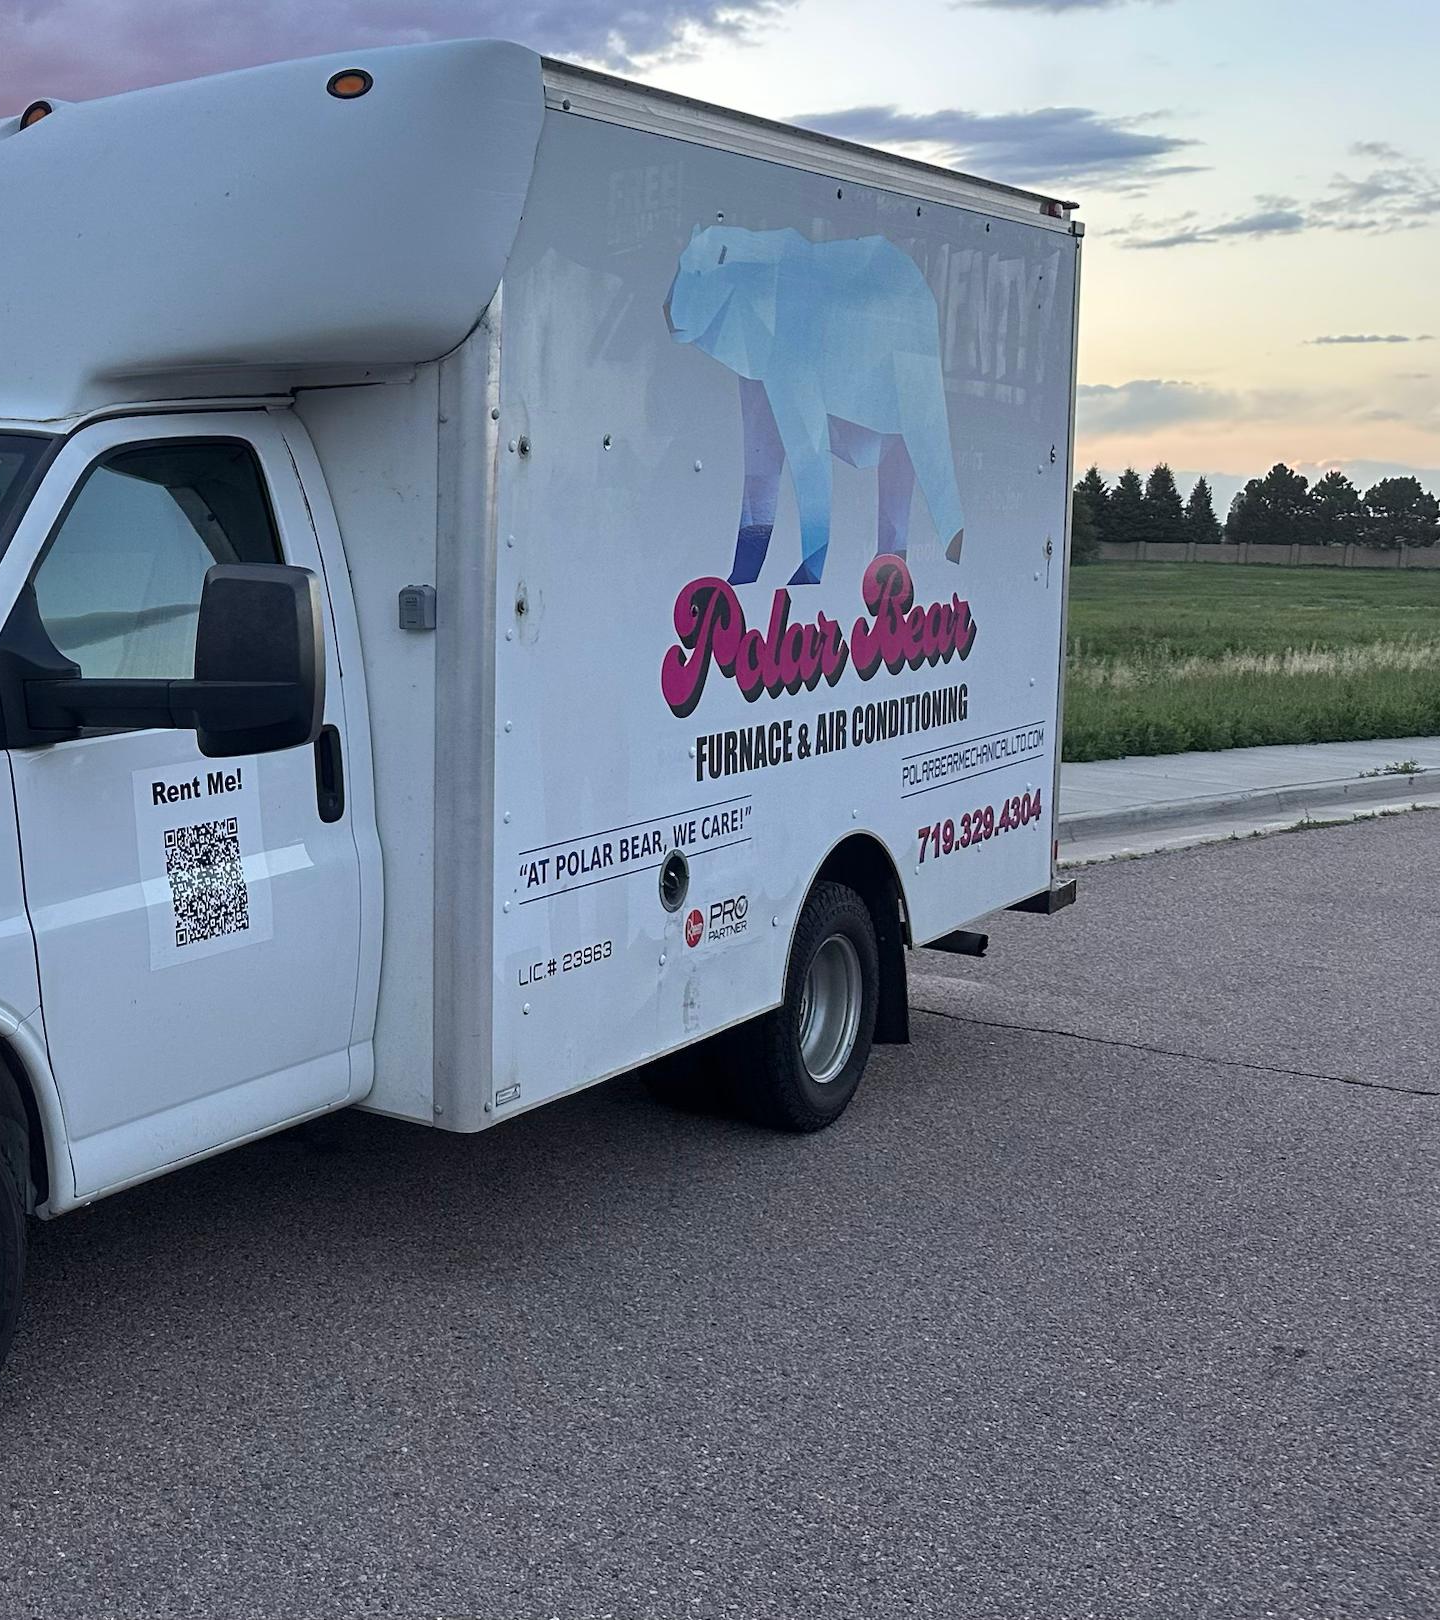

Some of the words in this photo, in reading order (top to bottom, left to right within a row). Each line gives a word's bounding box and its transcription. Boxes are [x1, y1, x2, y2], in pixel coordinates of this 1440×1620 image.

[661, 576, 850, 719] Polar
[850, 553, 978, 681] Bear
[695, 719, 794, 782] FURNACE
[798, 723, 812, 760] &
[815, 709, 847, 756] AIR
[851, 683, 969, 748] CONDITIONING
[902, 728, 1045, 788] POLARBEARMECHANICALLTD.COM
[151, 775, 201, 805] Rent
[206, 768, 243, 796] Me!
[555, 843, 614, 880] POLAR
[619, 830, 667, 864] BEAR,
[673, 820, 696, 848] WE
[917, 788, 1042, 864] 719.329.4304
[708, 920, 748, 943] PARTNER
[709, 895, 749, 929] PRO
[562, 941, 613, 972] 23963
